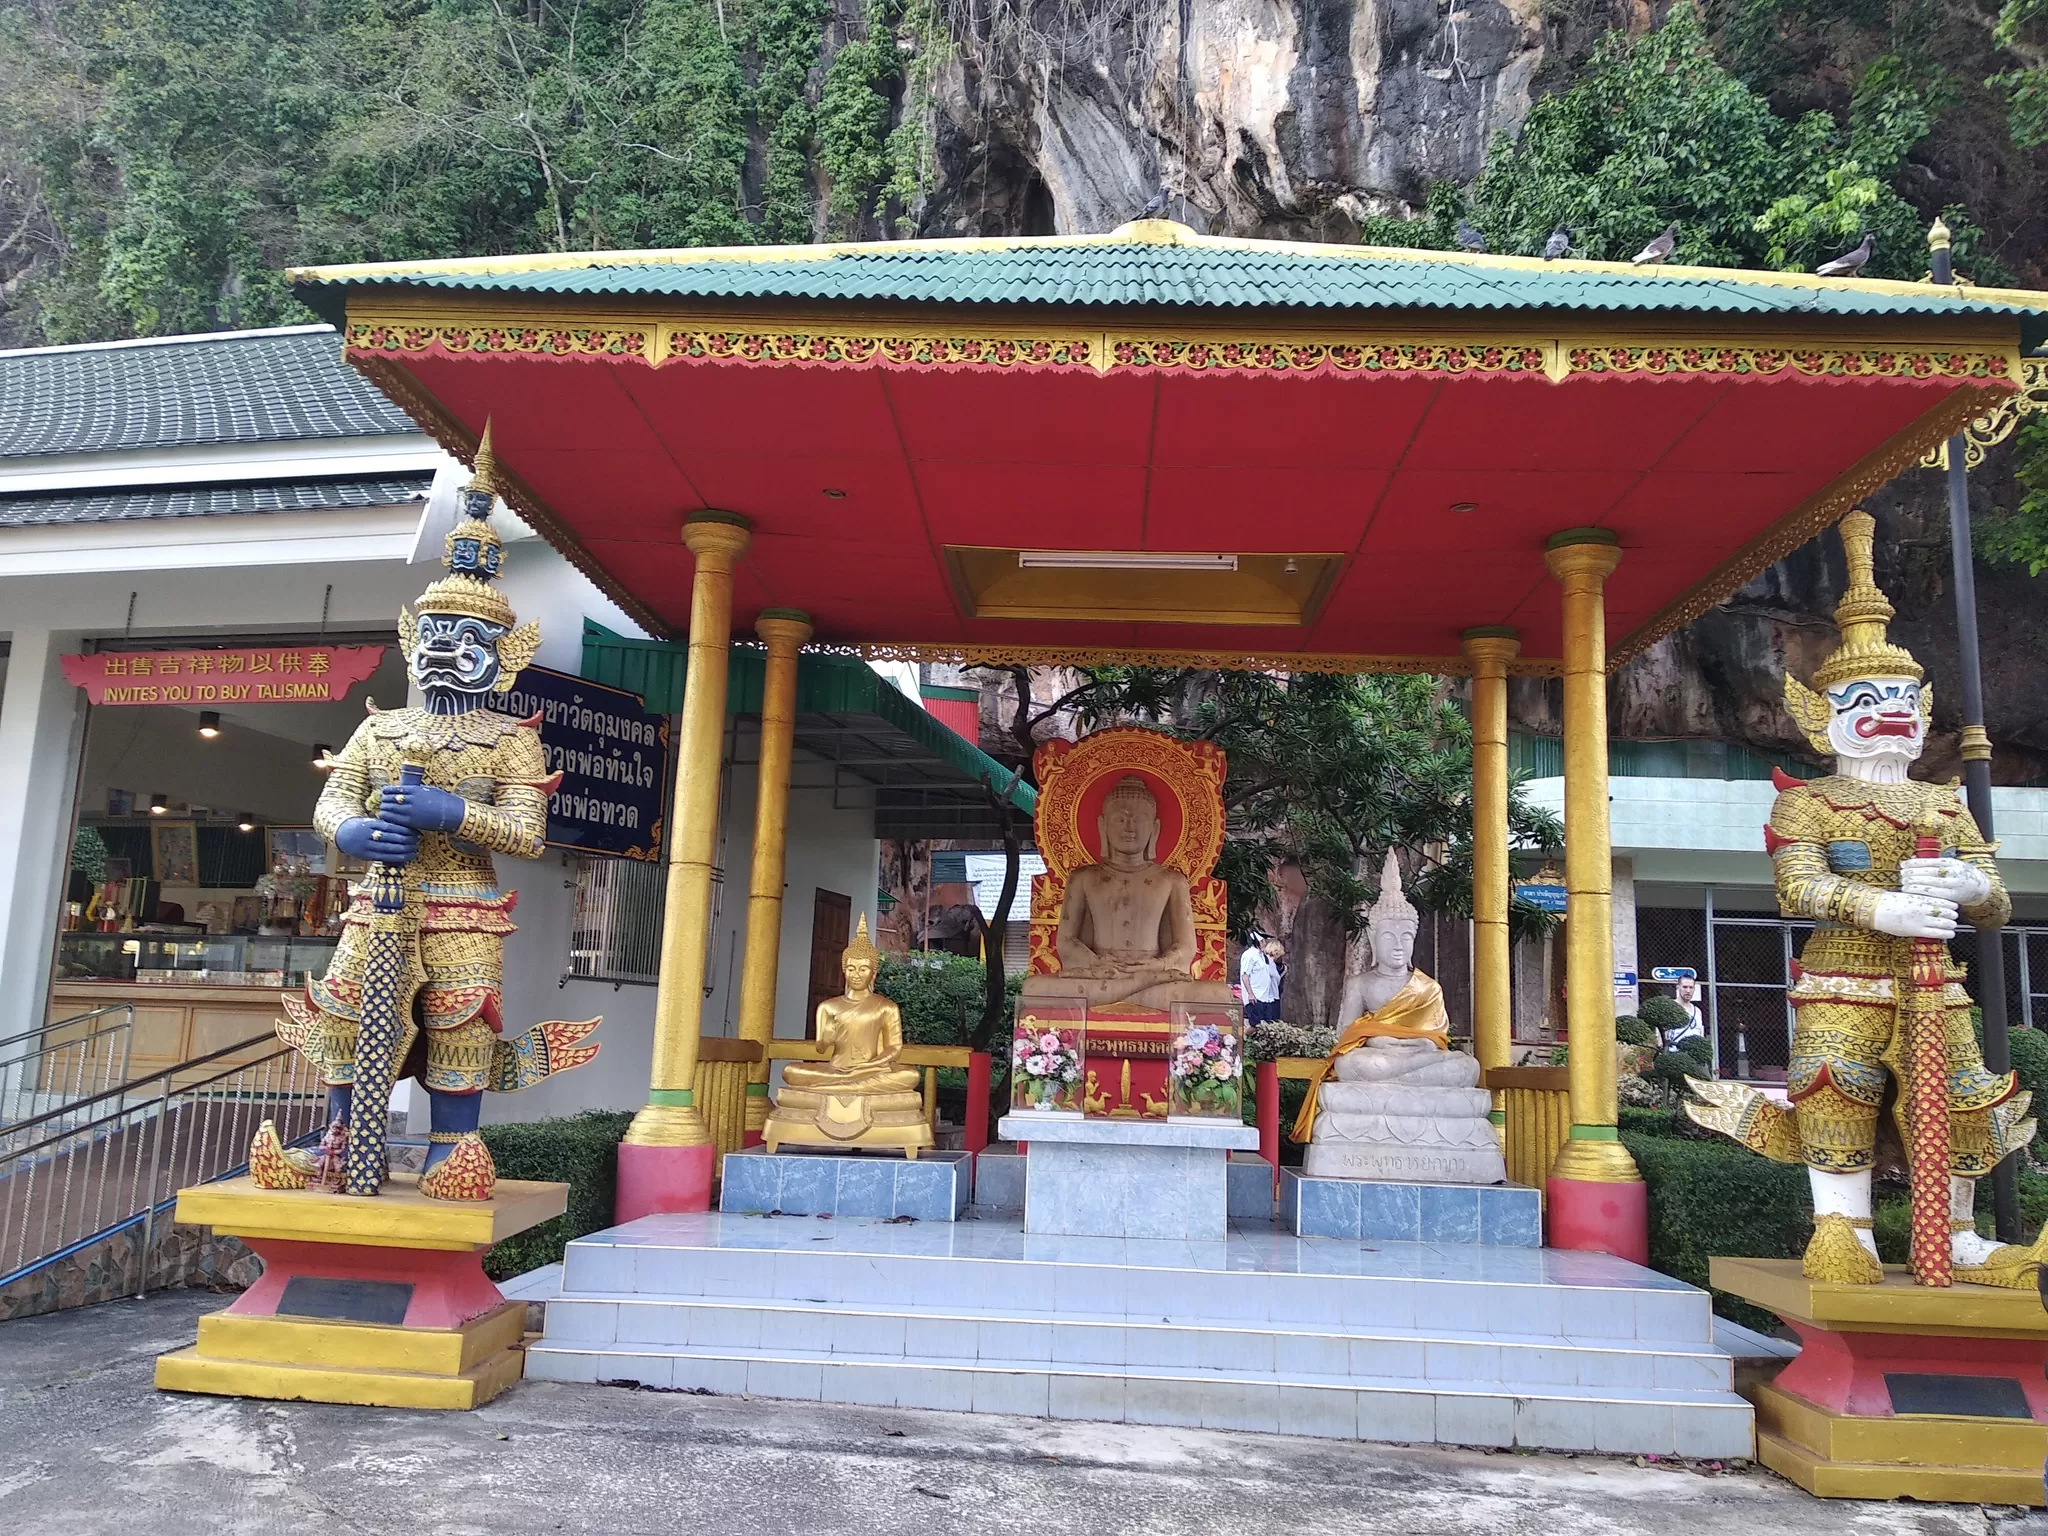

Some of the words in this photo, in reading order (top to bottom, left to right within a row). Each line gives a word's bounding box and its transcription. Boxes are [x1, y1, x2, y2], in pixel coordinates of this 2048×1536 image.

[104, 652, 330, 677] 出售吉祥物以供奉
[104, 685, 157, 702] INVITES
[161, 685, 192, 701] YOU
[197, 685, 218, 700] TO
[221, 684, 250, 700] BUY
[256, 682, 330, 699] TALISMAN
[542, 743, 654, 789] ลวงพ่อทันใจ
[549, 788, 639, 829] วงพ่อทวด
